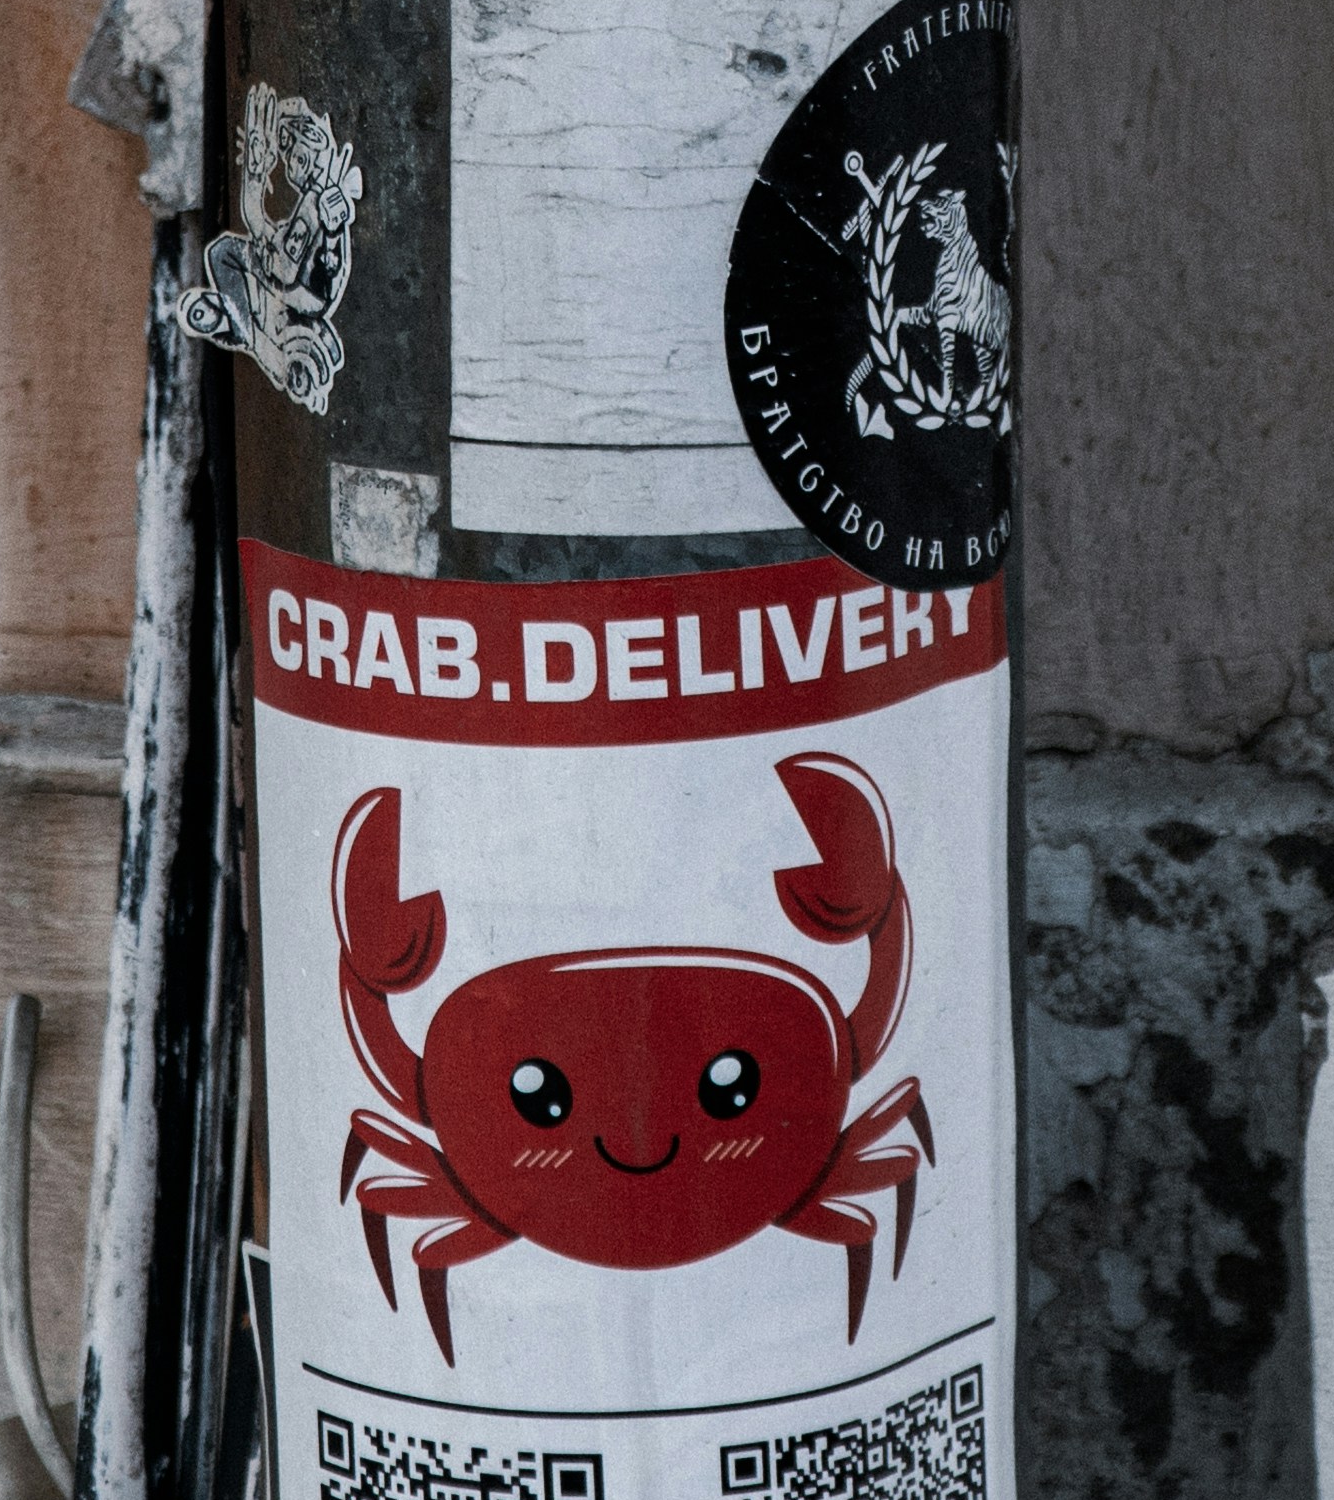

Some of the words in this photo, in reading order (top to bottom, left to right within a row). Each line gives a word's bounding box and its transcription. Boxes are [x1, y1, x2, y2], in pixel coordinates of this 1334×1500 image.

[740, 323, 884, 552] БРАТСТВО
[904, 536, 945, 570] НА
[267, 584, 977, 703] CRAB.DELIVERY
